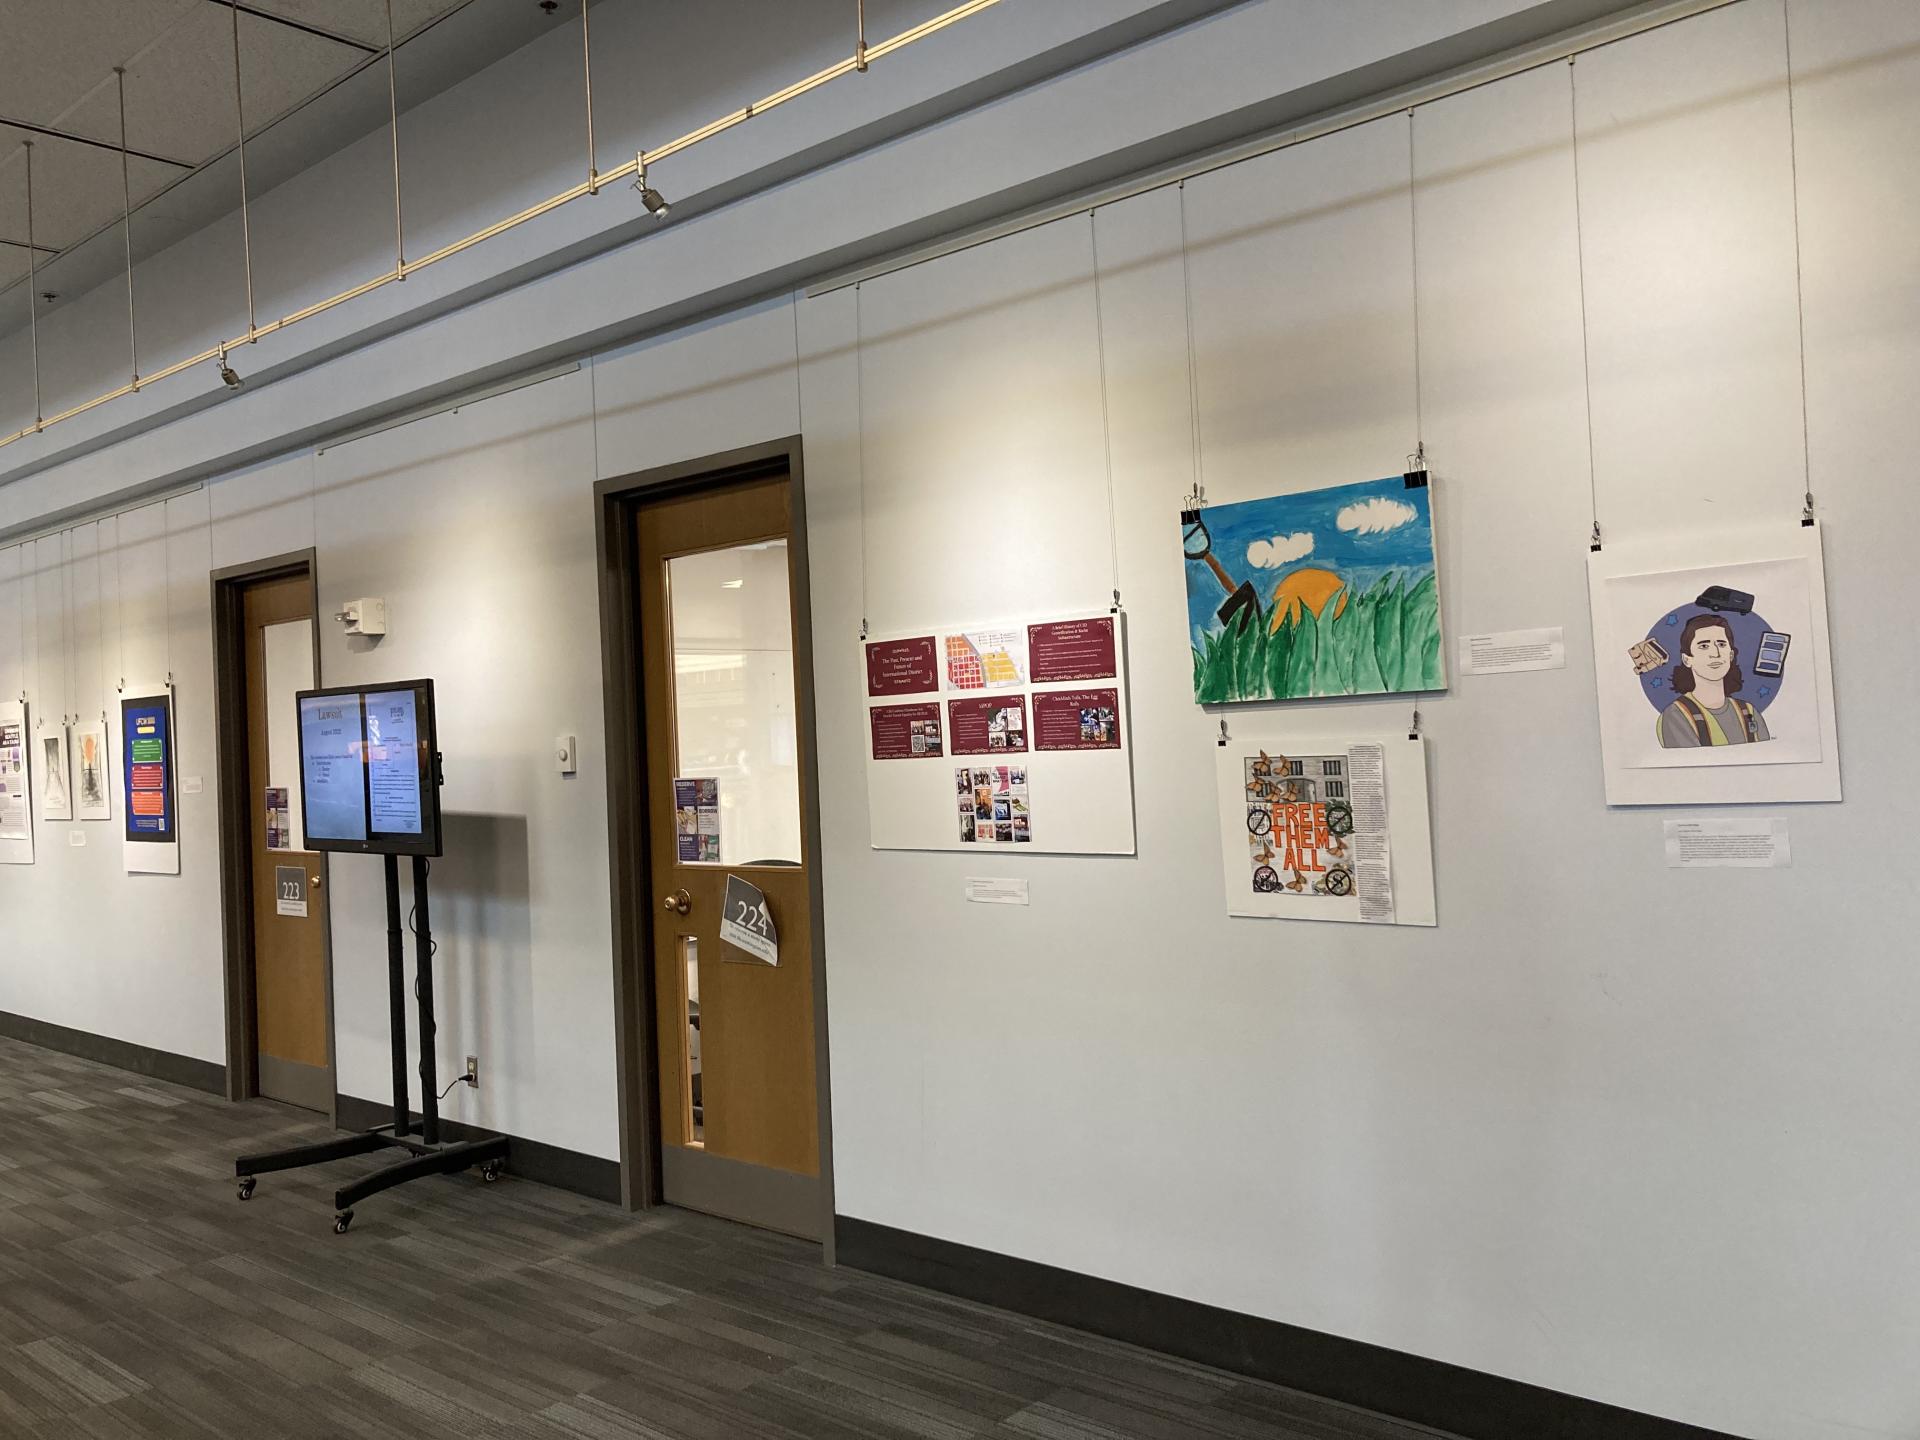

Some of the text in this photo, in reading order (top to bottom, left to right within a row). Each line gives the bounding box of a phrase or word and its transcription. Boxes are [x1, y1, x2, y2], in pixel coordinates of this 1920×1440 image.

[1271, 802, 1328, 828] FREE
[1270, 825, 1330, 849] THEM
[1283, 848, 1327, 872] ALL
[282, 881, 300, 900] 223
[735, 900, 768, 936] 224
